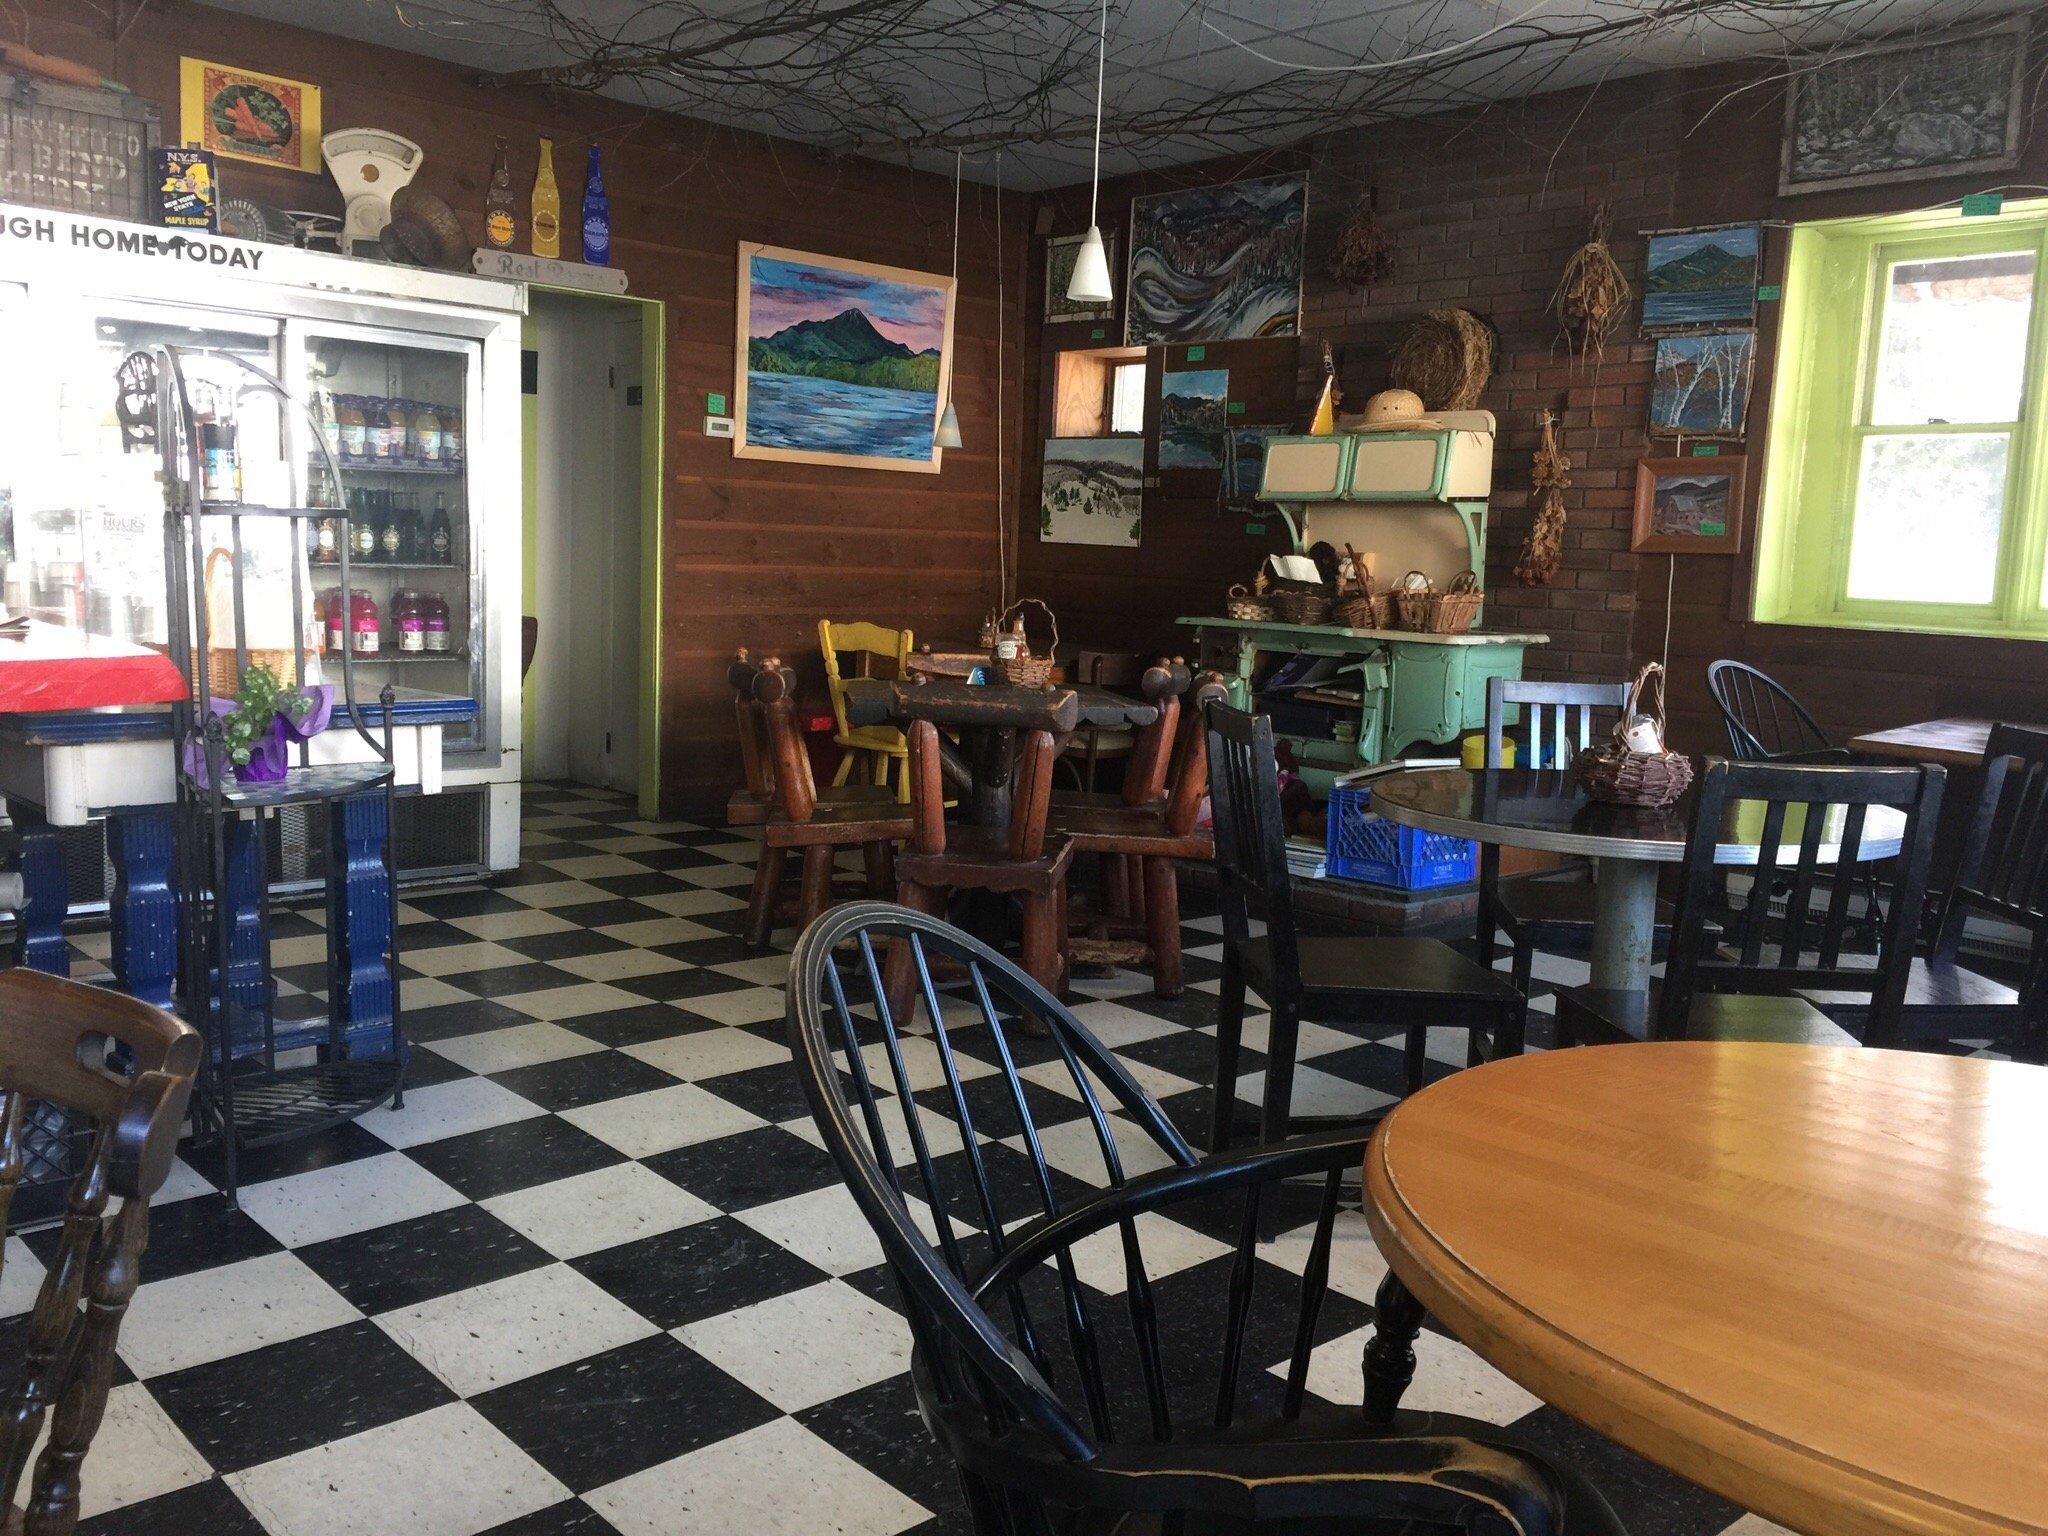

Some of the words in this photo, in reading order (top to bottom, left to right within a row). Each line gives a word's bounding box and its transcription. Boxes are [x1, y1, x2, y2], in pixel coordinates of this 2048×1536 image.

[167, 153, 201, 163] N.Y.S.
[164, 200, 178, 208] NEW
[178, 194, 196, 203] YORK
[173, 201, 194, 211] STATE
[165, 216, 186, 225] MAPLE
[187, 217, 209, 226] SYRUP
[72, 224, 156, 256] HOME
[170, 234, 263, 270] TODAY
[499, 254, 538, 278] Rest
[104, 517, 144, 529] HOURS
